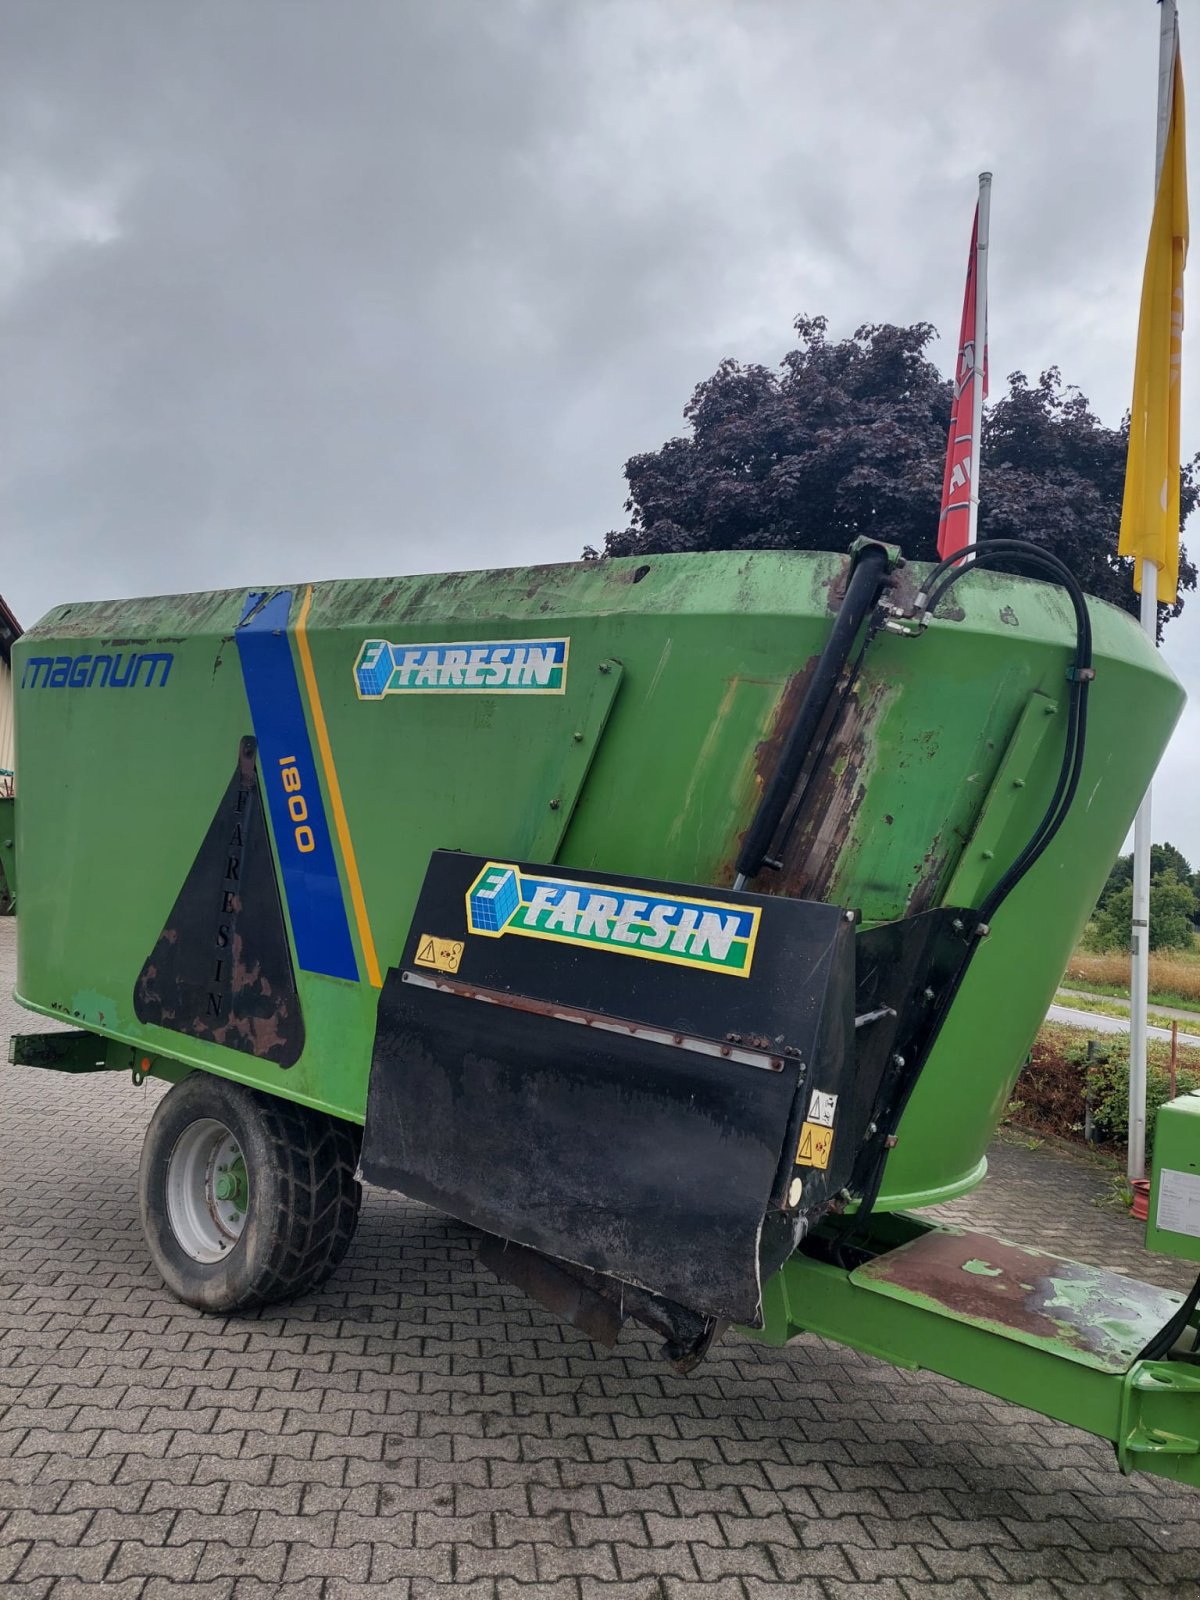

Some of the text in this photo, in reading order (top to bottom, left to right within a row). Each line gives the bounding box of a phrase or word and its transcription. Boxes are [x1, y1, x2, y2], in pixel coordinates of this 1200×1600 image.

[398, 647, 556, 685] FARESIN
[278, 755, 316, 853] 1800
[206, 790, 250, 1018] FARESIN
[523, 886, 741, 961] FARESIN
